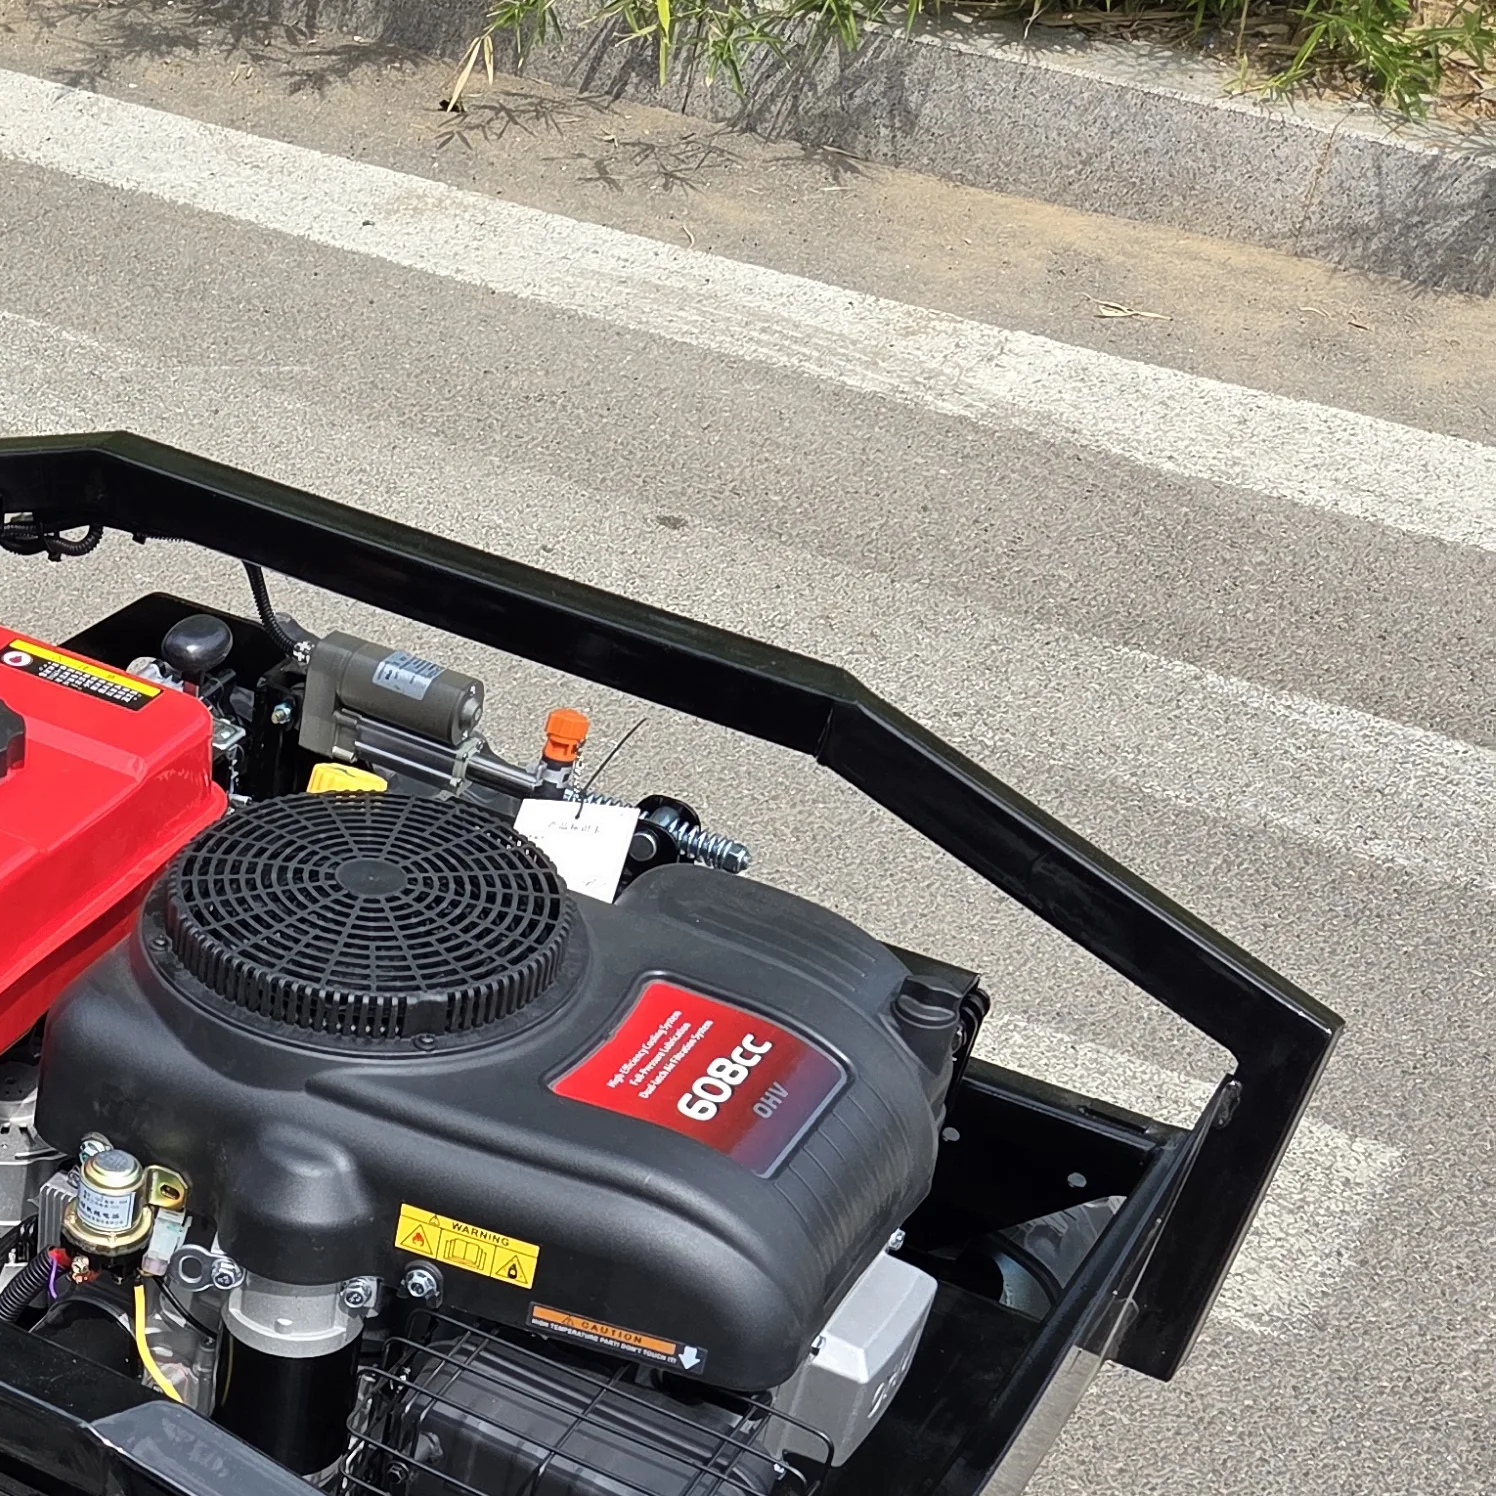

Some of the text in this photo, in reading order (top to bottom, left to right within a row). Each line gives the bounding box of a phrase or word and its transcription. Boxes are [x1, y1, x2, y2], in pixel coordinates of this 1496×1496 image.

[644, 1029, 667, 1050] Cooling
[659, 1010, 682, 1031] System
[659, 1022, 691, 1053] Lubrication
[670, 1039, 697, 1064] Filtration
[691, 1020, 713, 1041] System
[677, 1033, 773, 1121] 608cc
[753, 1081, 789, 1119] OHV
[452, 1221, 510, 1247] WARNING
[531, 1318, 550, 1328] HIGH
[549, 1322, 599, 1342] TEMPERATURE
[581, 1321, 642, 1344] CAUTION
